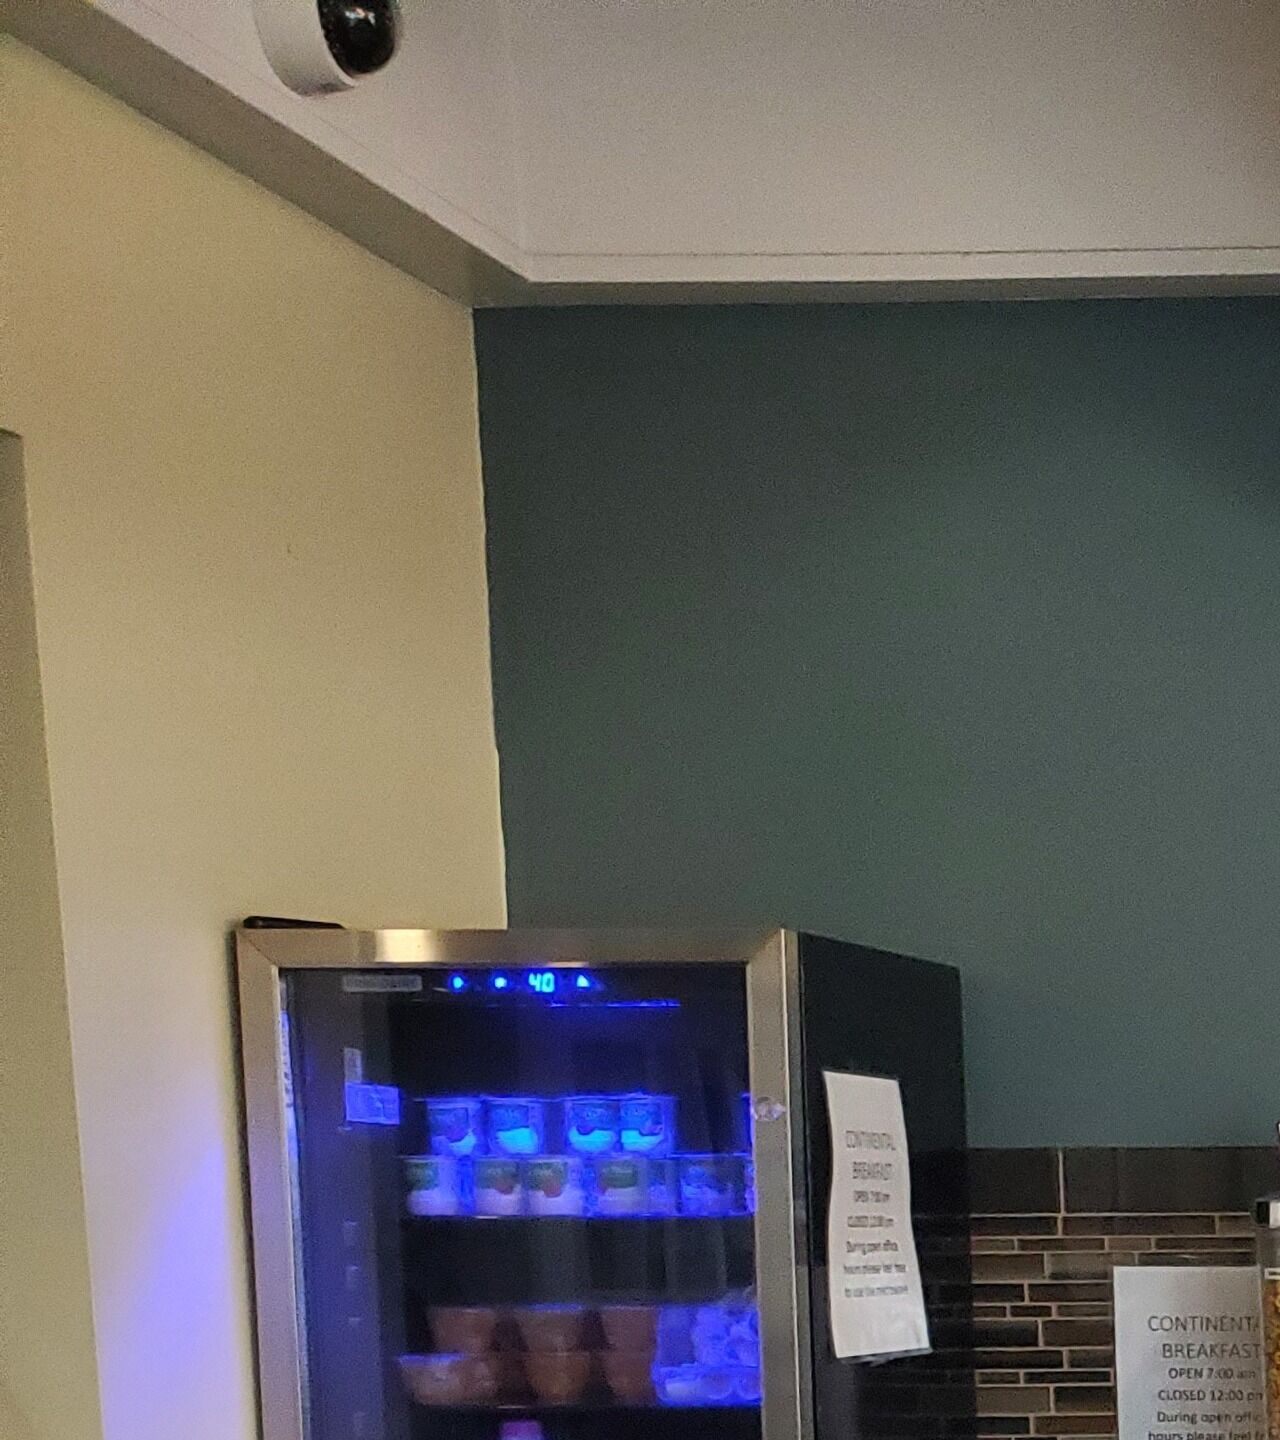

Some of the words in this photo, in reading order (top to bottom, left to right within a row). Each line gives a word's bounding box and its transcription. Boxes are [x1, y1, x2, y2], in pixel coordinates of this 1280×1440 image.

[528, 973, 554, 992] 40
[1162, 1343, 1262, 1359] BREAKFAST
[1168, 1367, 1203, 1379] OPEN
[1158, 1389, 1206, 1401] CLOSED
[1210, 1389, 1244, 1401] 12:00
[1157, 1411, 1197, 1424] During
[1200, 1413, 1231, 1424] open
[1148, 1431, 1183, 1440] hours
